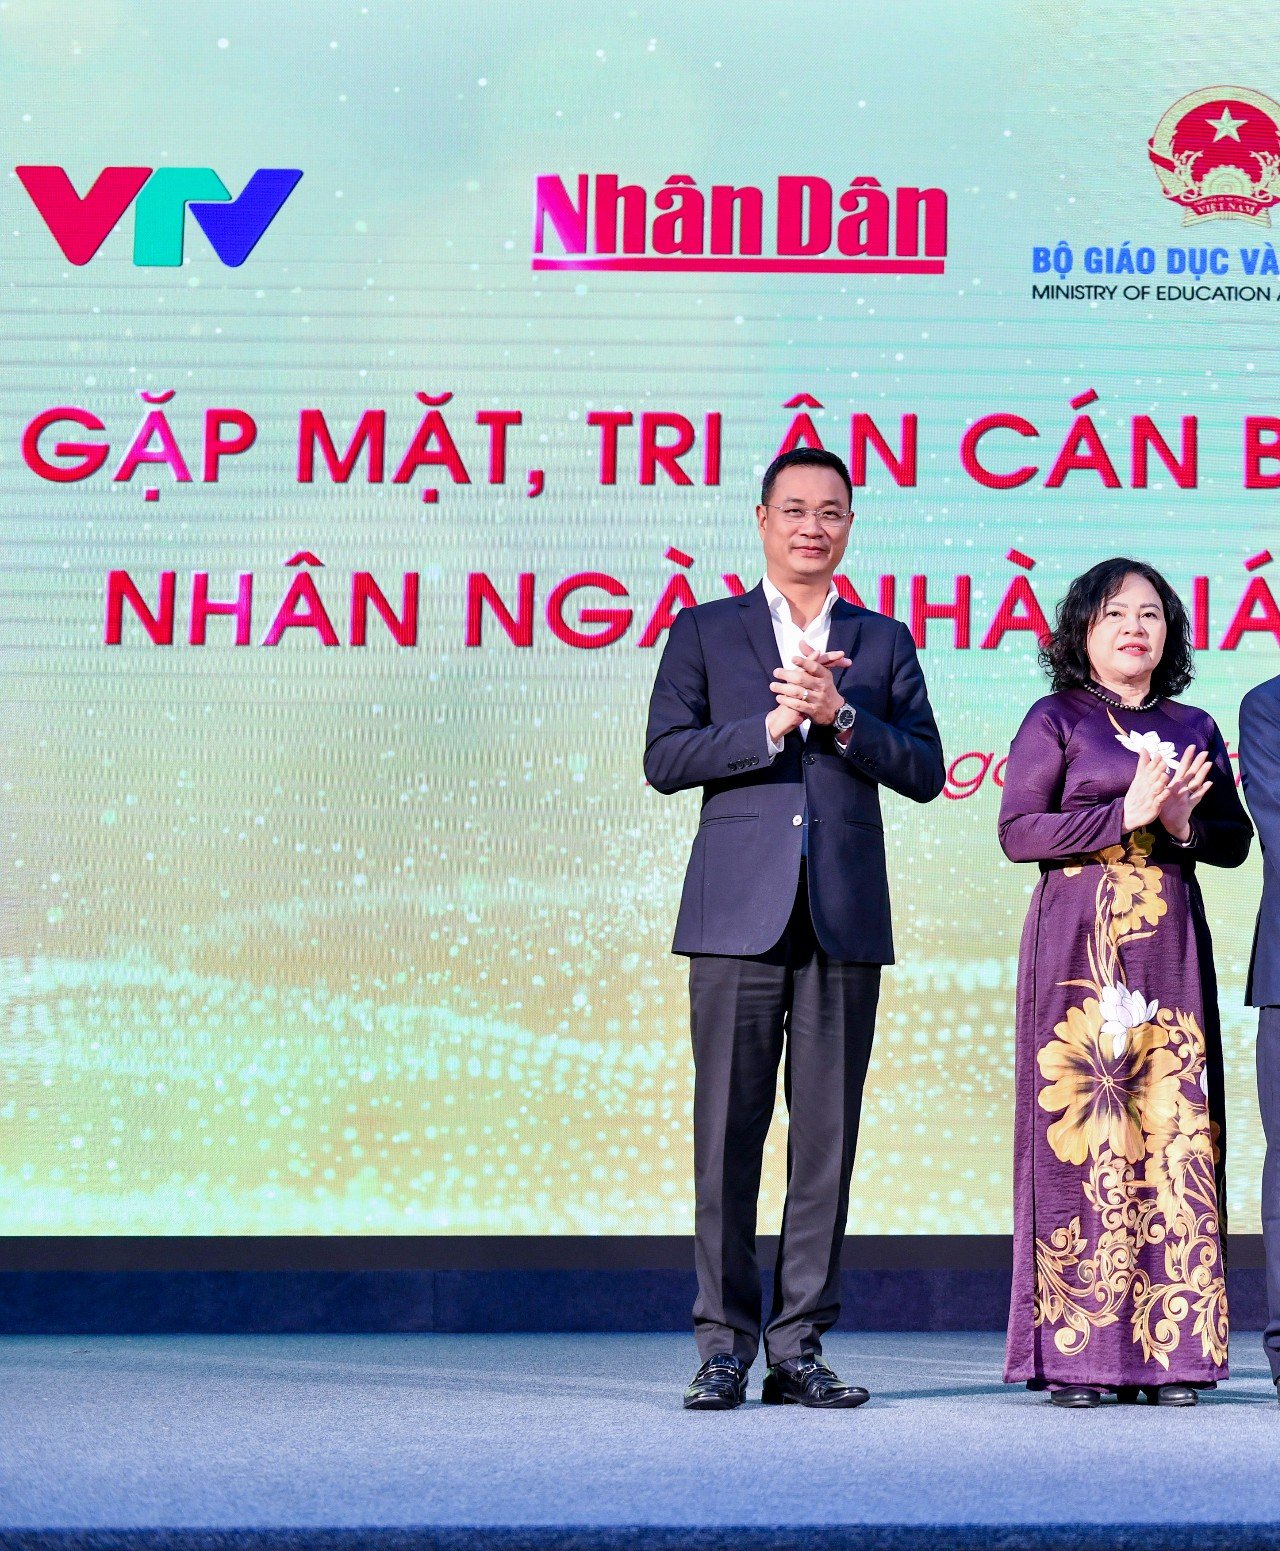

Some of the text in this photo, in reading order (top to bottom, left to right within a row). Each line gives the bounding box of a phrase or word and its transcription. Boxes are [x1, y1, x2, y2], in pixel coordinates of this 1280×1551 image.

[14, 164, 304, 268] VTV
[532, 172, 948, 258] Nhân Dân
[1032, 240, 1074, 281] BỘ
[1083, 240, 1157, 276] GIÁO
[1166, 246, 1230, 281] DỤC
[1239, 241, 1280, 276] VÀ
[1032, 284, 1118, 300] MINISTRY
[1123, 285, 1150, 301] OF
[1156, 285, 1271, 301] EDUCATION
[20, 389, 258, 502] GẶP
[295, 391, 545, 503] MẶT,
[586, 410, 722, 486] TRI
[768, 392, 918, 487] ÂN
[959, 388, 1198, 489] CÁN
[103, 550, 420, 647] NHÂN
[464, 546, 746, 648] NGÀ
